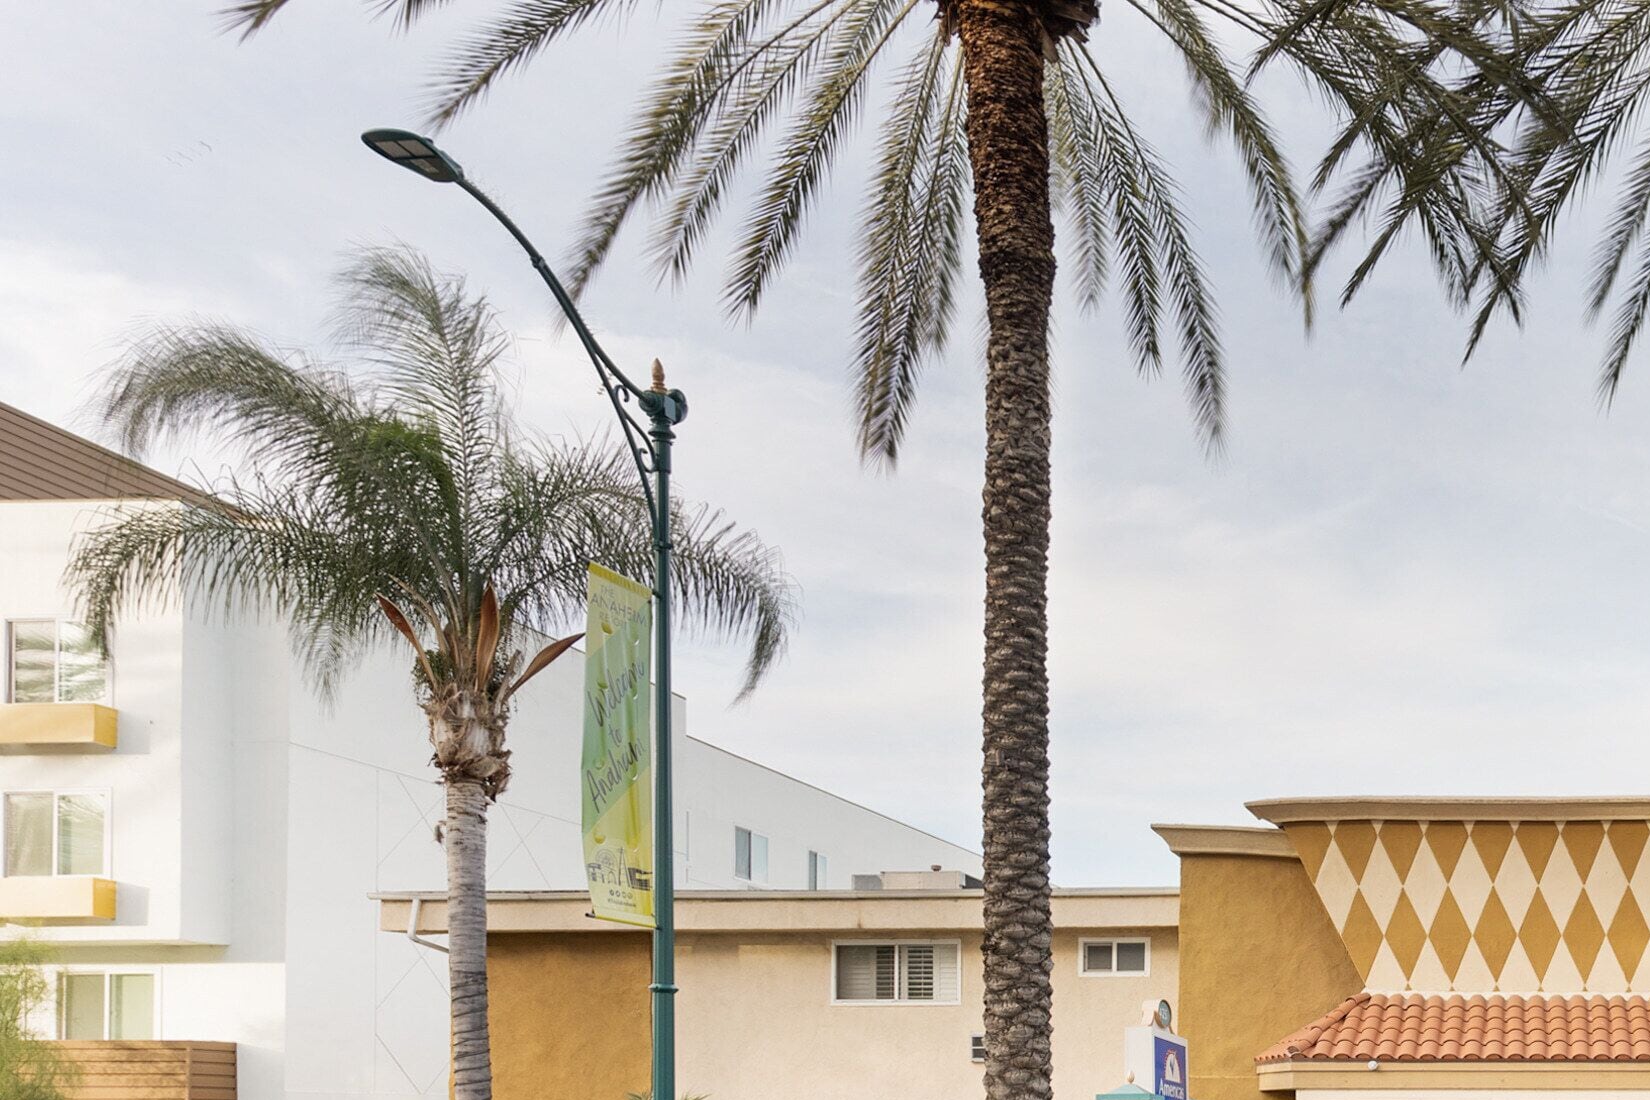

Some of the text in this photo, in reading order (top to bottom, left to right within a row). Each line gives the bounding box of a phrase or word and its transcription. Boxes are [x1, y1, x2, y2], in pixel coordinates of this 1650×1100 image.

[590, 593, 648, 628] ANAHEIM
[587, 660, 645, 727] Welcome
[607, 723, 623, 748] to
[586, 737, 646, 814] Anaheim
